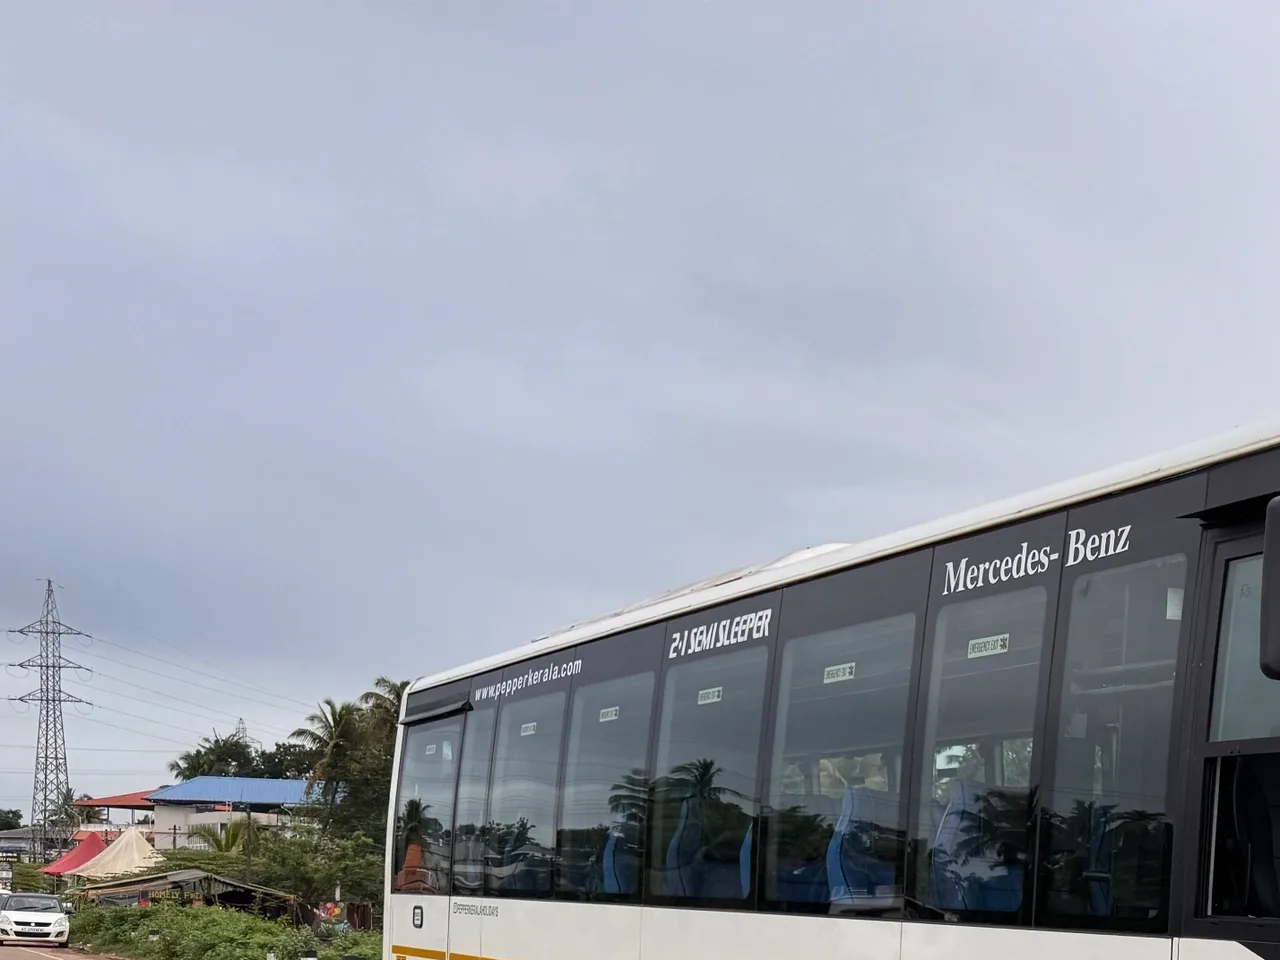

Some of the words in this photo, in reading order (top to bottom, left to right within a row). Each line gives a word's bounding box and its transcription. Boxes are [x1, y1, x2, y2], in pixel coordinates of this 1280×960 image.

[1065, 525, 1131, 567] Benz
[687, 622, 718, 654] SEMI
[715, 608, 772, 648] SLEEPER
[474, 659, 582, 701] www.pepperkerala.com
